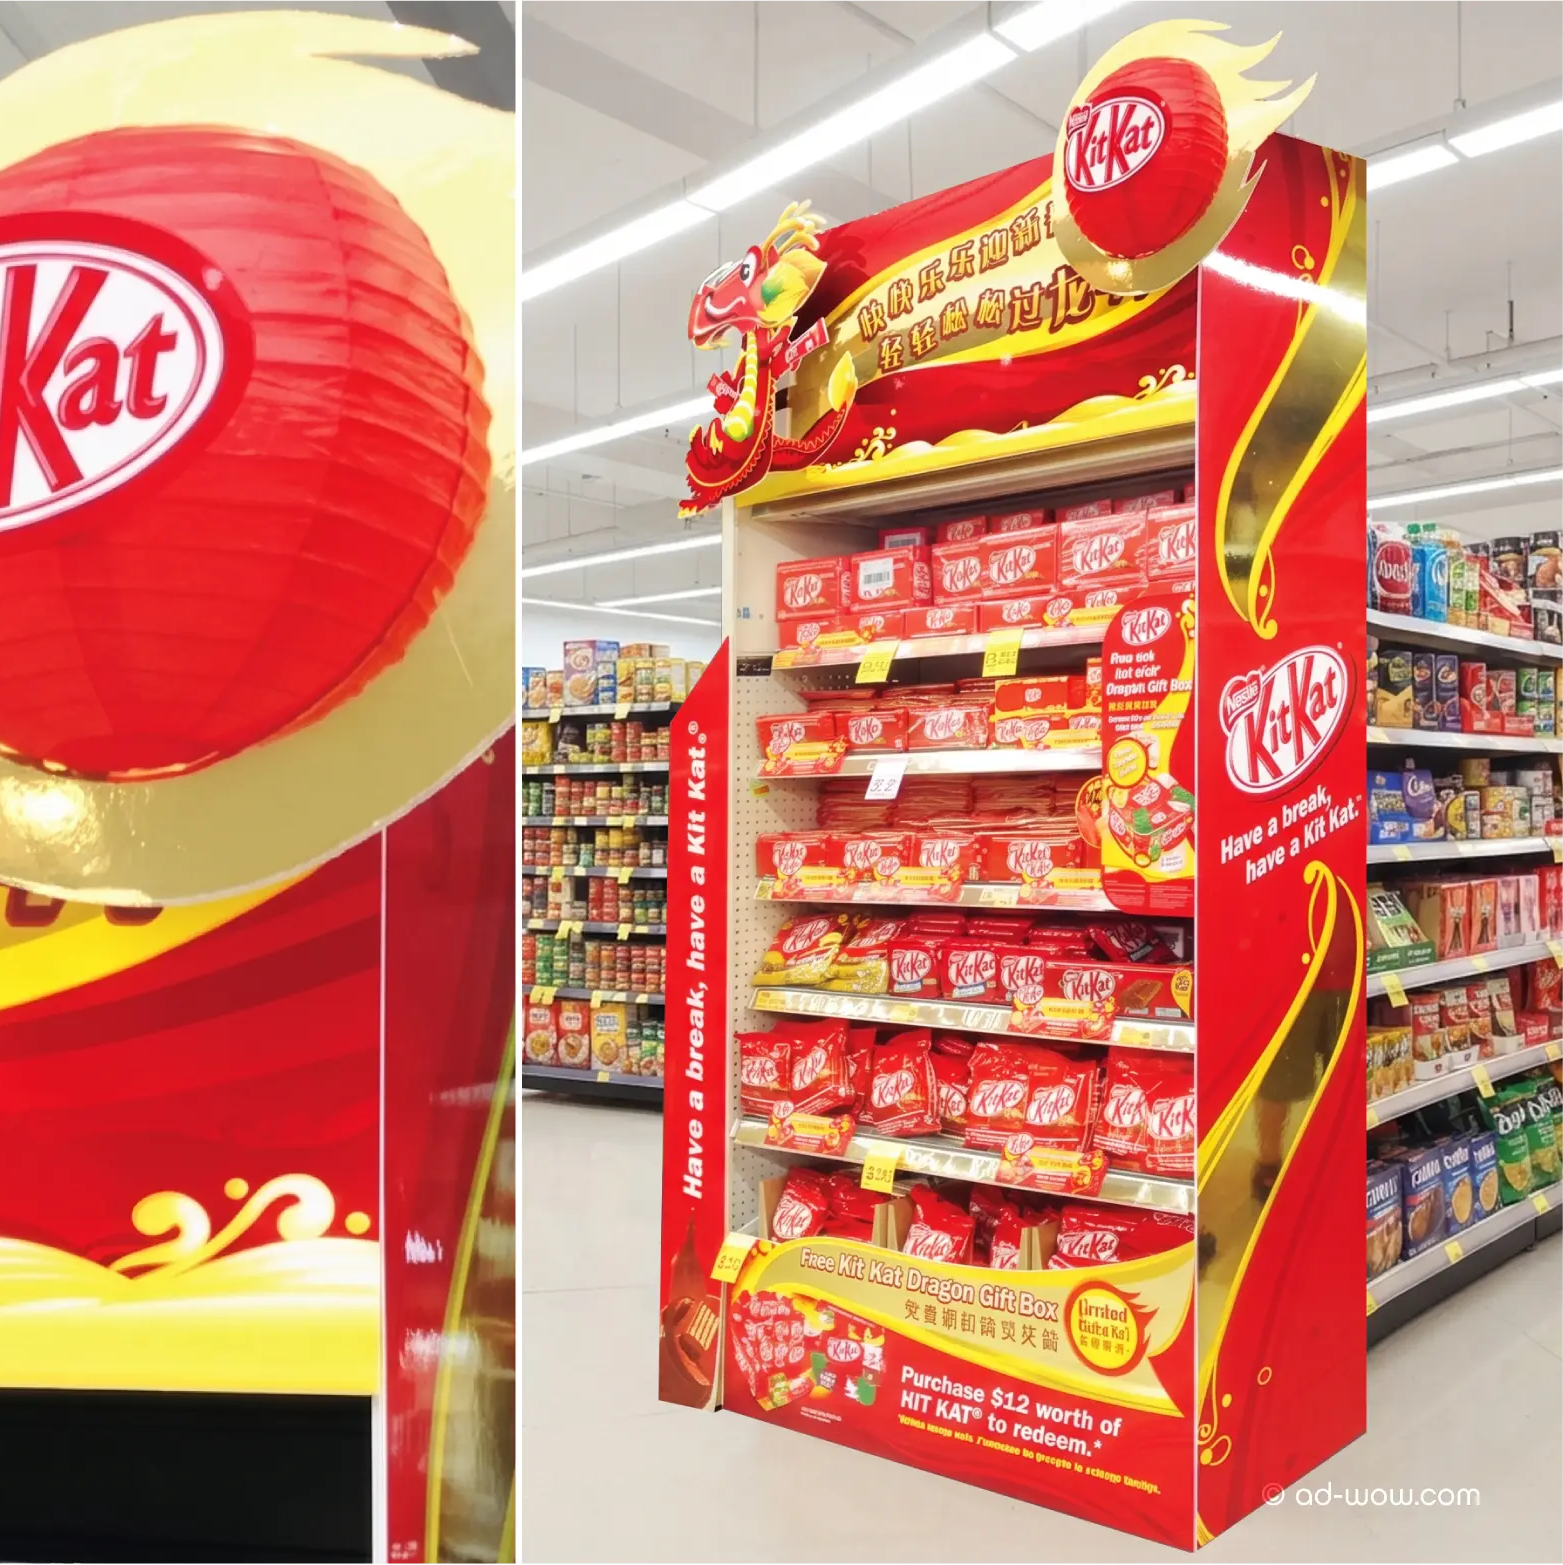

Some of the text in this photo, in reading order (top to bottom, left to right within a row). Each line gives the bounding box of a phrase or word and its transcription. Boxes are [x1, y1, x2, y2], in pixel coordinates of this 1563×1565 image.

[1075, 104, 1155, 185] KitKat
[857, 200, 1055, 342] 快快乐乐迎新
[878, 264, 1148, 373] 轻轻松松过龙
[1245, 655, 1337, 783] KitKat
[687, 809, 706, 855] Kit
[1221, 784, 1331, 865] Have a break,
[1245, 845, 1285, 885] have
[1289, 837, 1300, 857] a
[1304, 815, 1326, 849] Kit
[690, 865, 706, 885] a
[686, 894, 706, 971] have
[686, 981, 708, 1082] break,
[689, 1090, 704, 1111] a
[683, 1118, 703, 1200] Have
[838, 1253, 865, 1280] Kit
[869, 1260, 903, 1288] Kat
[906, 1268, 975, 1304] Dragon
[979, 1284, 1017, 1314] Gift
[1019, 1292, 1060, 1322] Box
[901, 1365, 1123, 1438] Purchase $12 worth of
[988, 1413, 1007, 1434] to
